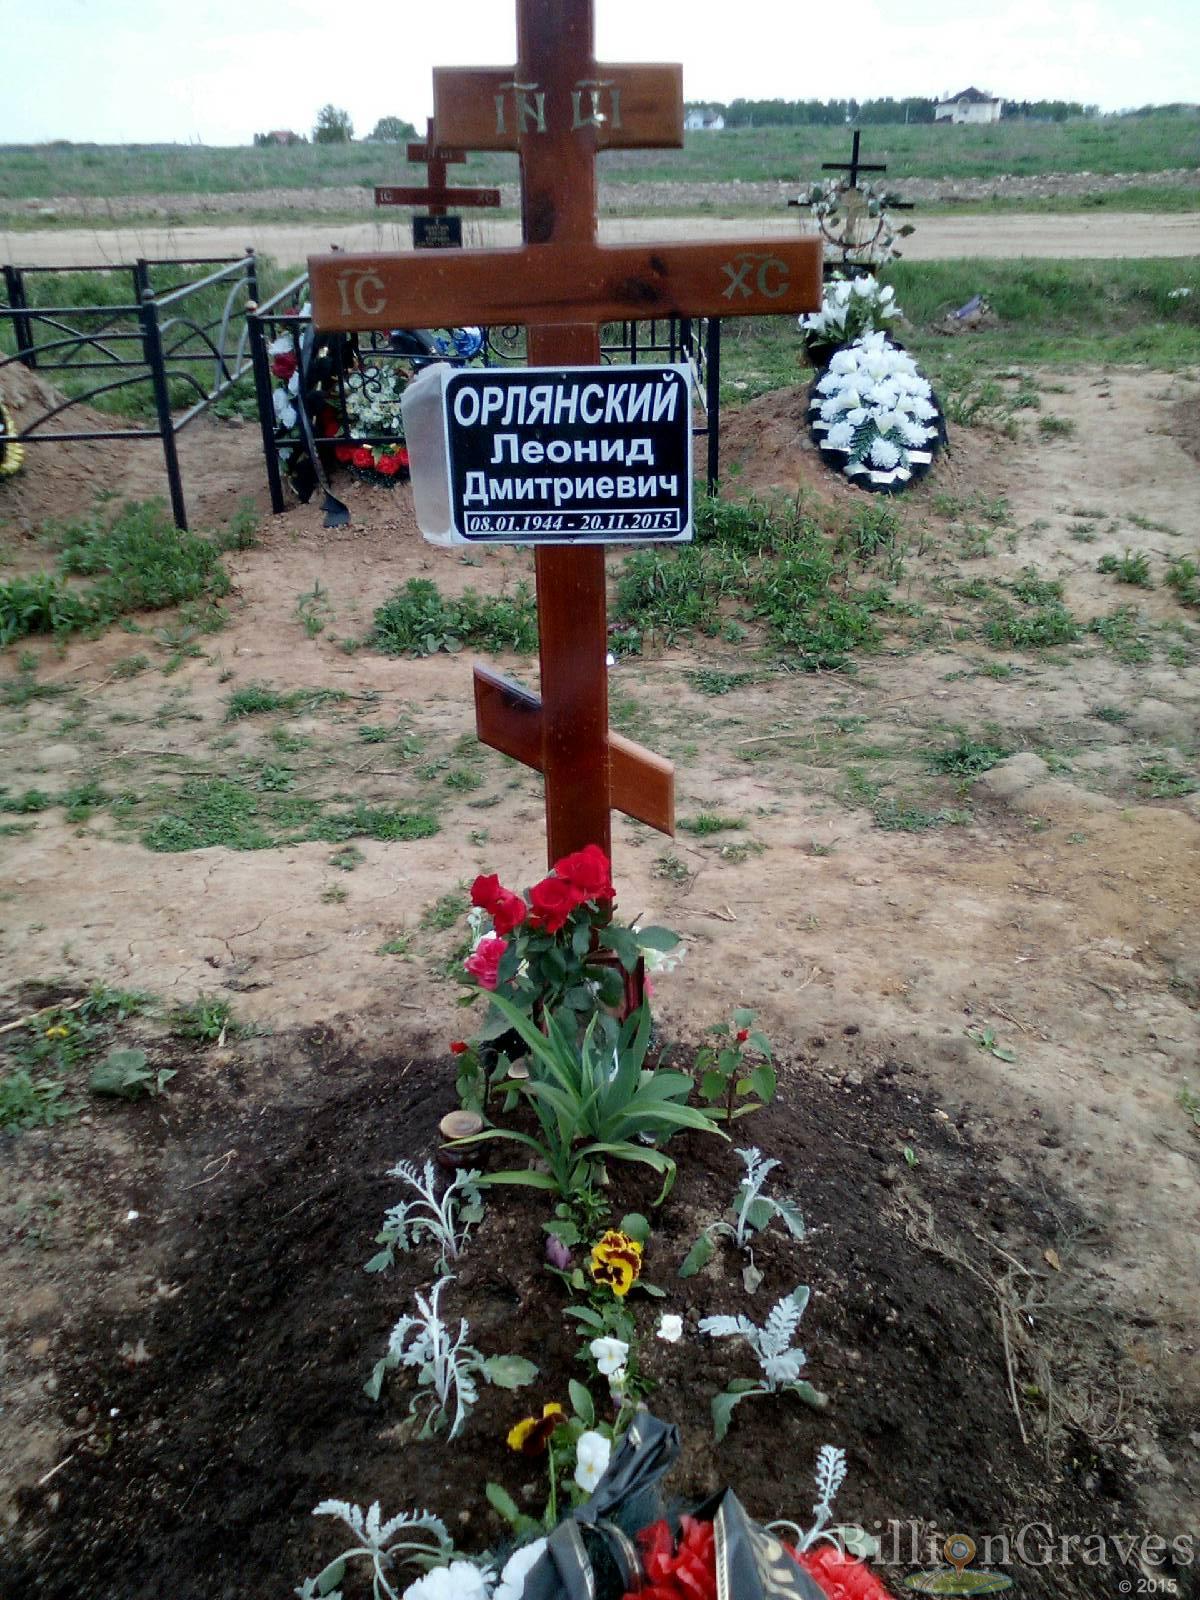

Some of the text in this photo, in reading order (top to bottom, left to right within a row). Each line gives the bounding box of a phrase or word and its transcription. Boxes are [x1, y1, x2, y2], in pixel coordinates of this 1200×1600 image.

[453, 372, 679, 426] ОРЛЯНСКИЙ
[490, 433, 655, 466] Леонид
[463, 471, 678, 506] Дмитриевич
[470, 515, 563, 532] 08.01.1944
[580, 512, 673, 530] 20.11.2015
